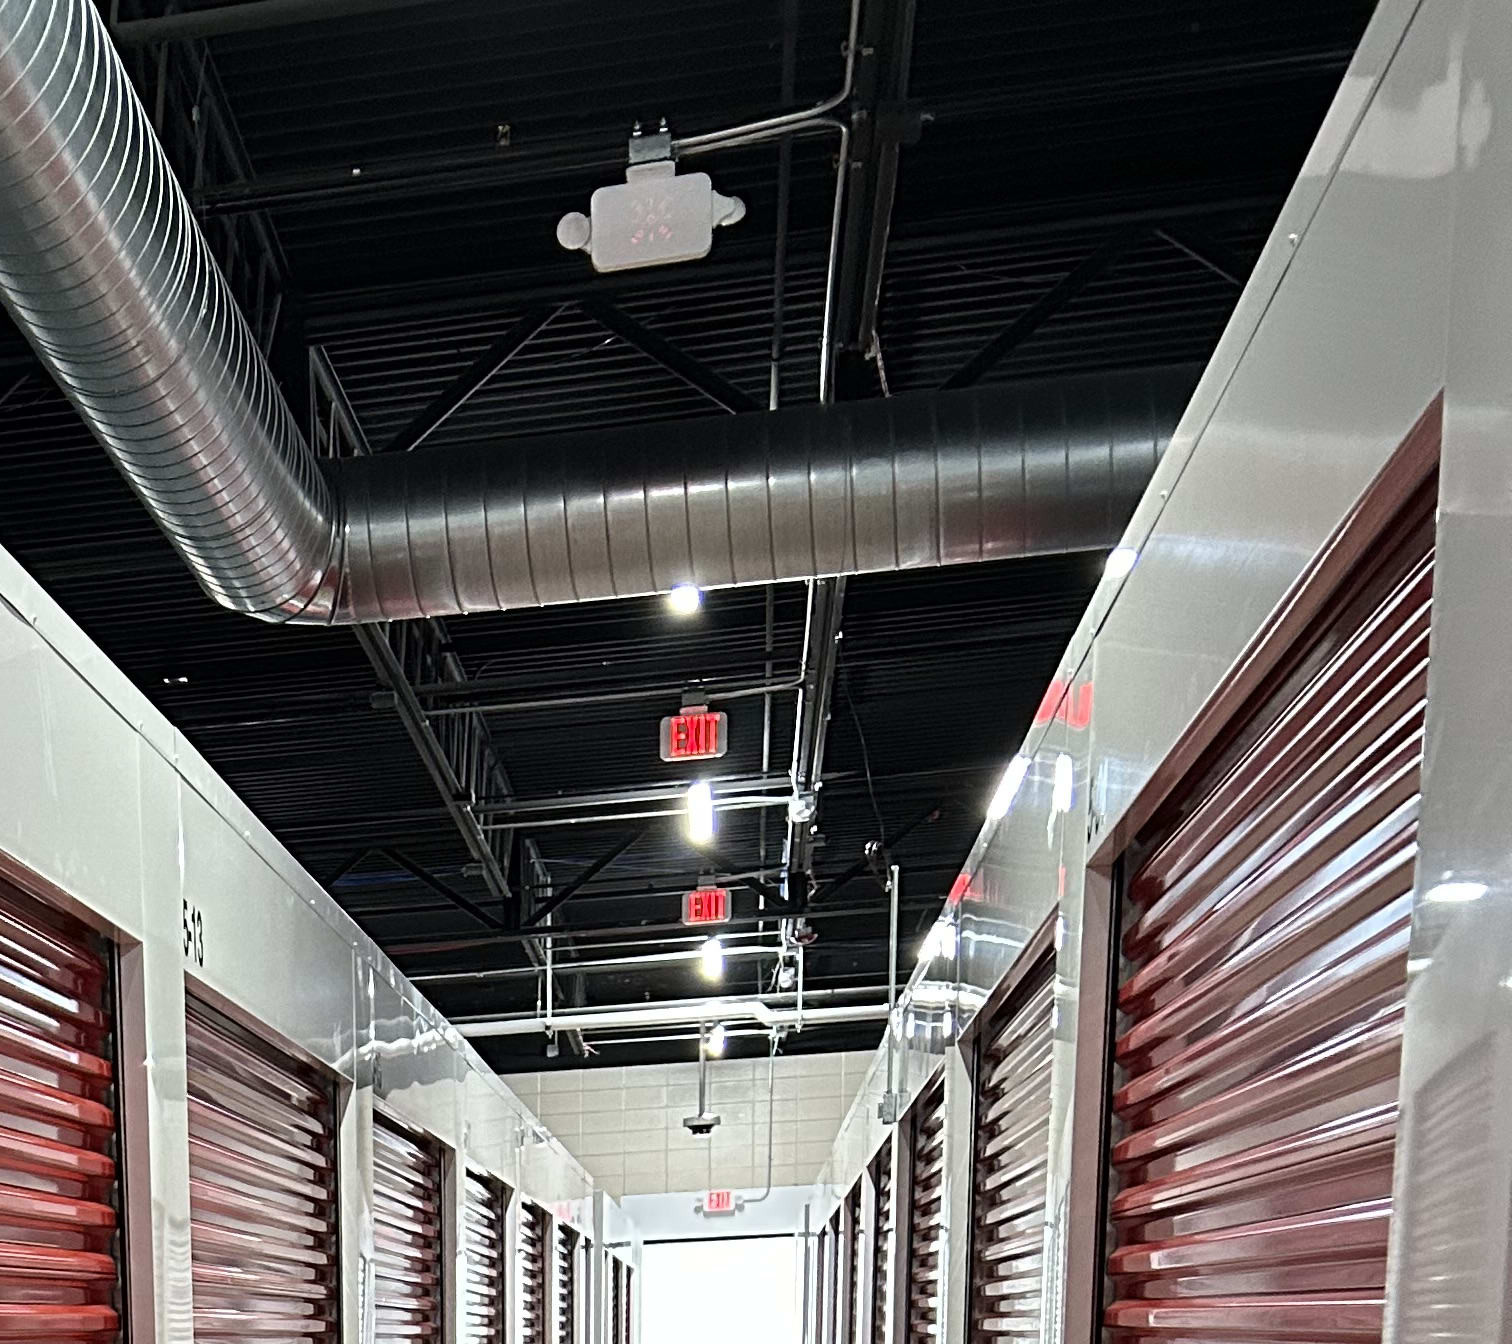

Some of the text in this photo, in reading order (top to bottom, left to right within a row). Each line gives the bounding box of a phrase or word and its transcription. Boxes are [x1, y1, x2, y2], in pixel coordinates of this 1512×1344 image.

[670, 713, 720, 756] EXIT
[689, 889, 726, 921] EXIT
[183, 898, 204, 967] 5-13
[708, 1191, 731, 1208] EXIT
